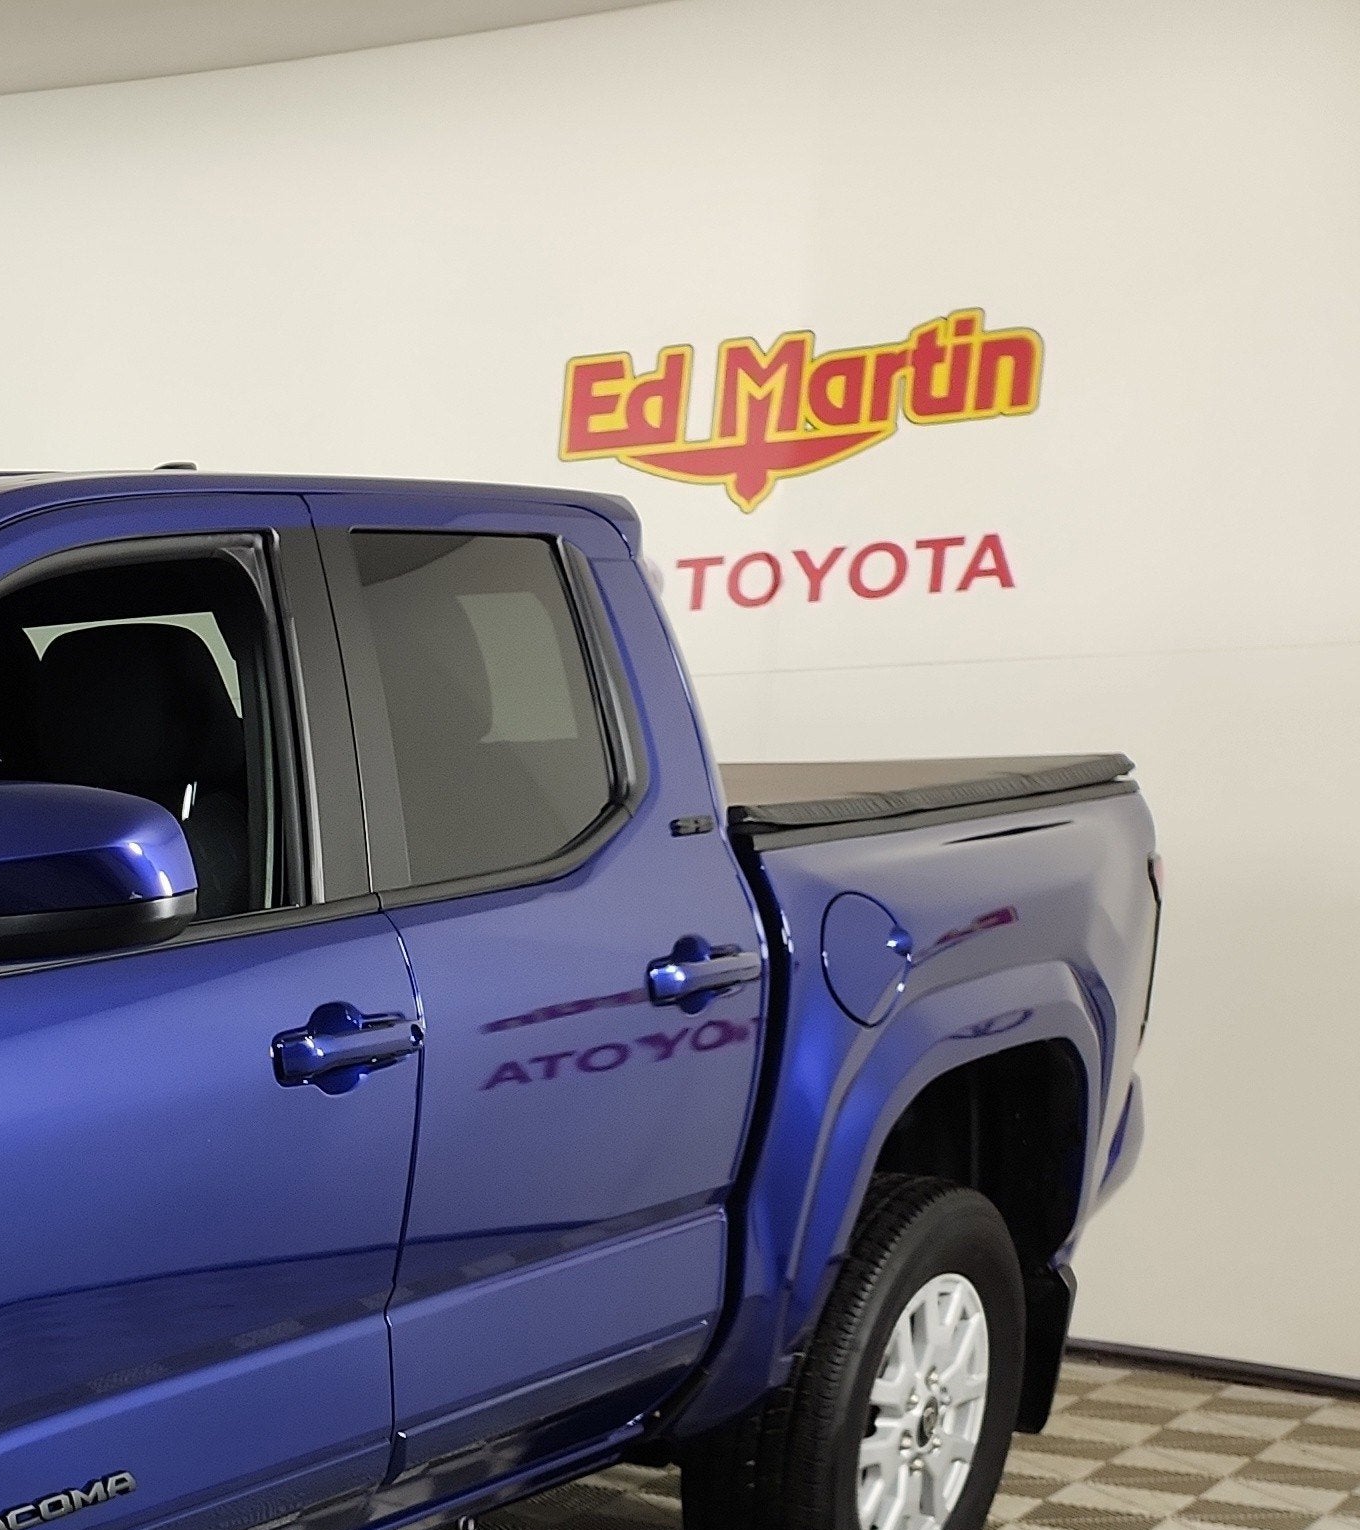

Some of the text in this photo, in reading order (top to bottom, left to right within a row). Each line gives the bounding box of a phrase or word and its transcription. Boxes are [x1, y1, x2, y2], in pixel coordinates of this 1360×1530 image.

[559, 307, 1044, 461] Ed Martin
[677, 534, 1015, 610] TOYOTA
